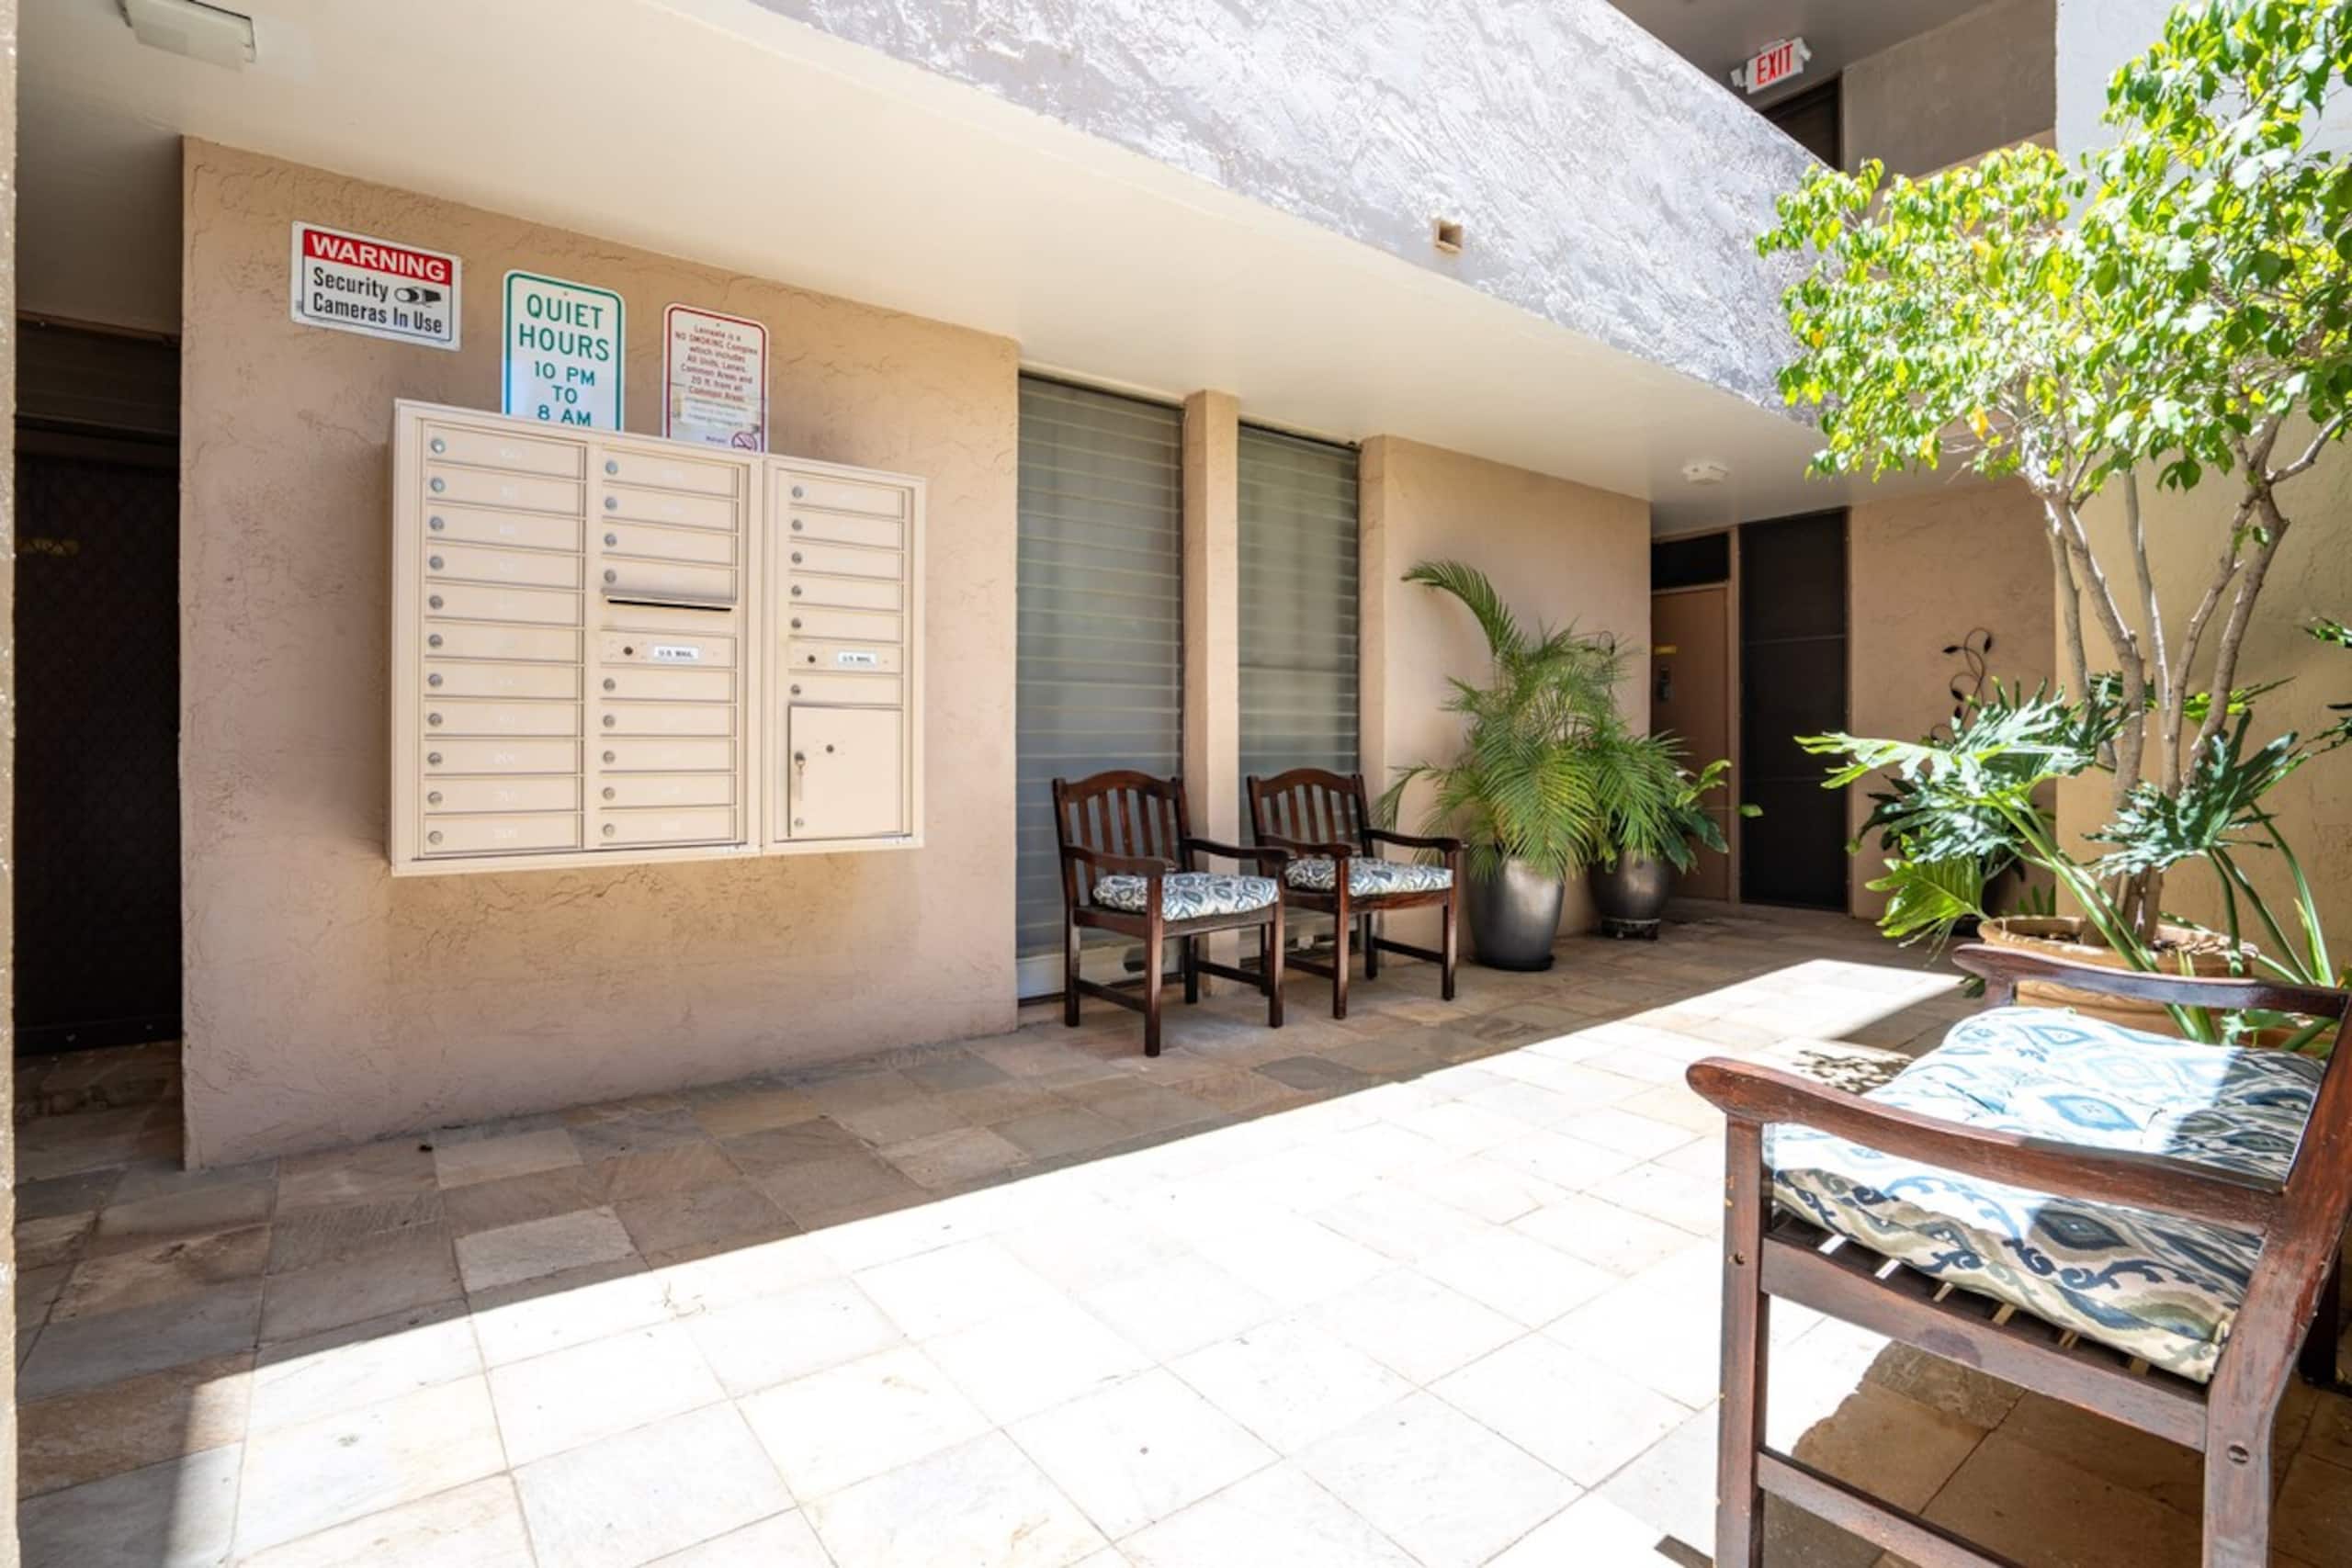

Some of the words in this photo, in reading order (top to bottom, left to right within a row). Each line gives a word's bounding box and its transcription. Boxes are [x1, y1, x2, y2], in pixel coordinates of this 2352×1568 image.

[1757, 43, 1793, 85] EXIT
[311, 234, 446, 282] WARNING
[313, 266, 389, 303] Security
[313, 292, 388, 324] Cameras
[393, 307, 409, 328] In
[414, 310, 443, 333] Use
[526, 293, 604, 330] QUIET
[519, 322, 610, 361] HOURS
[675, 331, 686, 341] NO
[689, 333, 724, 349] SMOKING
[727, 341, 758, 355] Complex
[535, 360, 557, 379] 10
[566, 367, 595, 386] PM
[681, 362, 715, 376] Common
[739, 375, 753, 384] and
[691, 375, 702, 385] 20
[552, 385, 578, 404] TO
[537, 404, 550, 421] 8
[561, 409, 592, 426] AM
